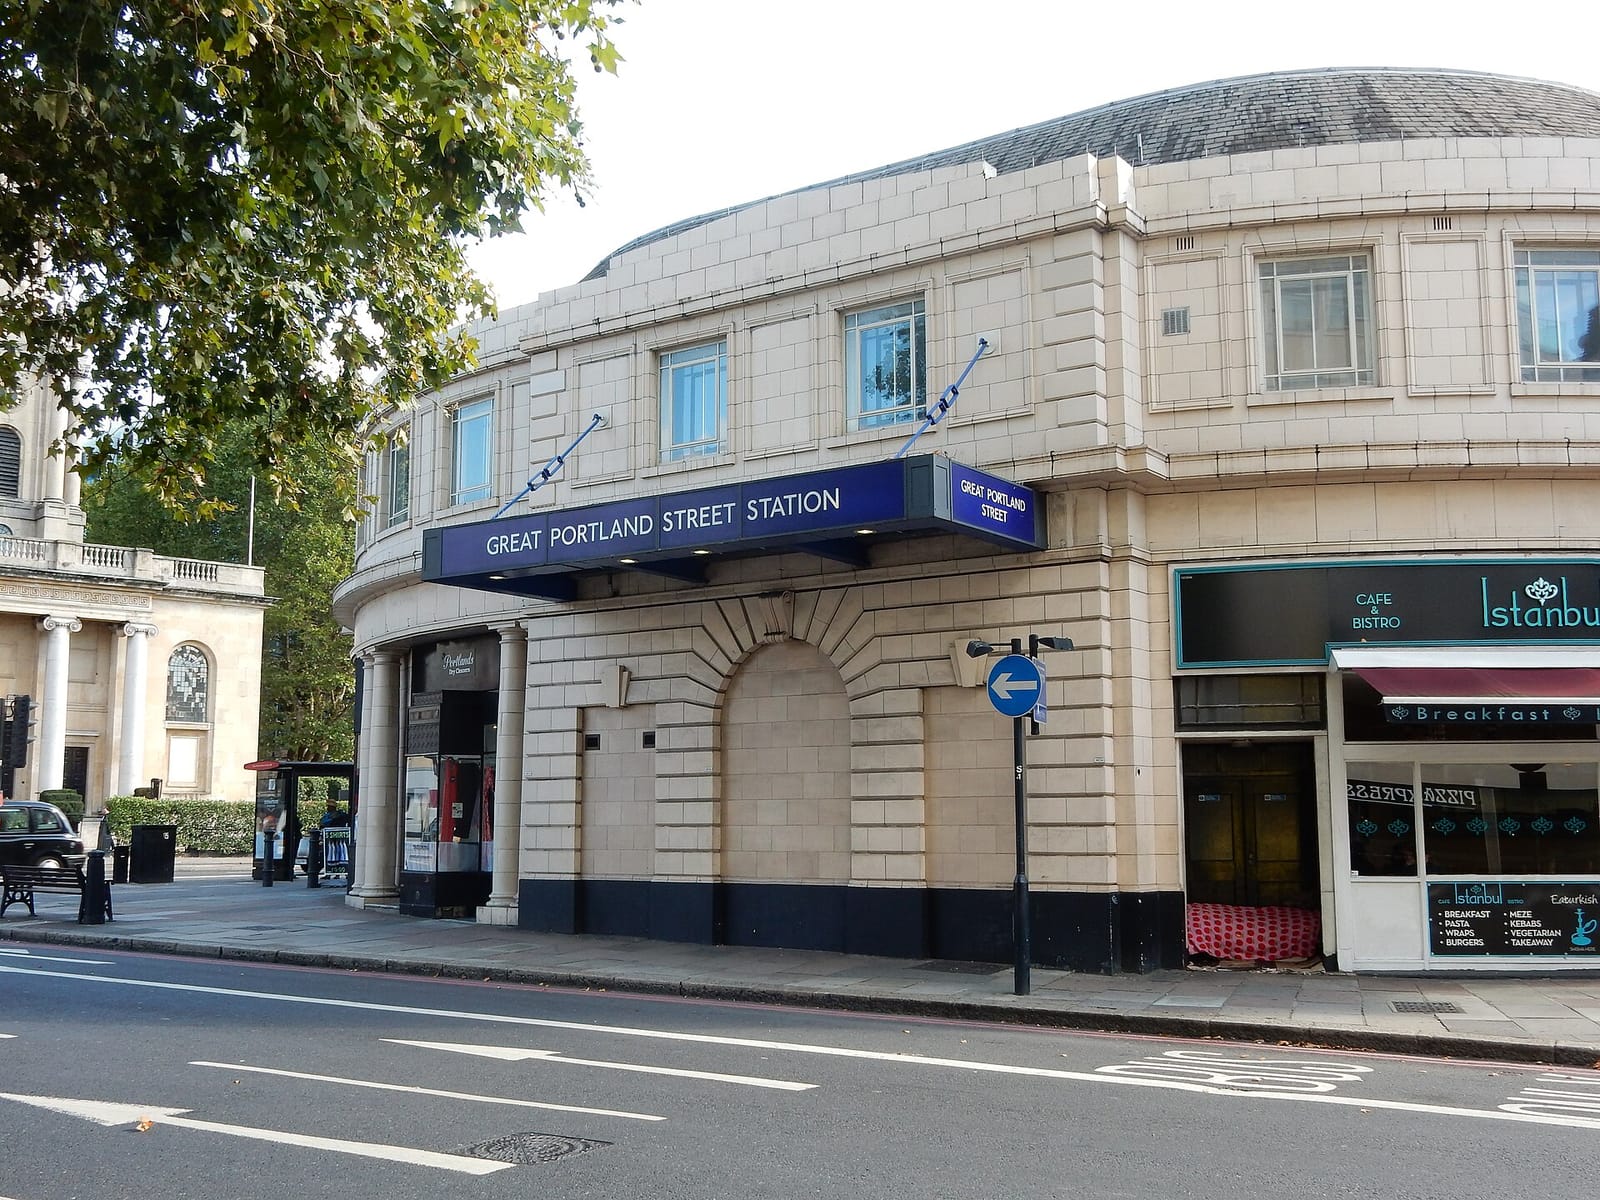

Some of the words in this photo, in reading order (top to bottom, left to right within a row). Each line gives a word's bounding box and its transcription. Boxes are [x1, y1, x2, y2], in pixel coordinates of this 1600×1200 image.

[961, 480, 985, 498] GREAT
[987, 488, 1026, 512] PORTLAND
[981, 503, 1008, 523] STREET
[486, 530, 542, 555] GREAT
[550, 514, 653, 547] PORTLAND
[662, 502, 736, 533] STREET
[746, 487, 840, 521] STATION
[1356, 593, 1392, 605] CAFE
[1481, 576, 1600, 627] Istanbu
[1370, 605, 1379, 615] &
[1352, 616, 1400, 629] BISTRO
[1417, 706, 1550, 721] Breakfast
[1454, 883, 1502, 904] Istanbul
[1550, 894, 1598, 905] Eaturkish
[1510, 929, 1561, 937] VEGETARIAN
